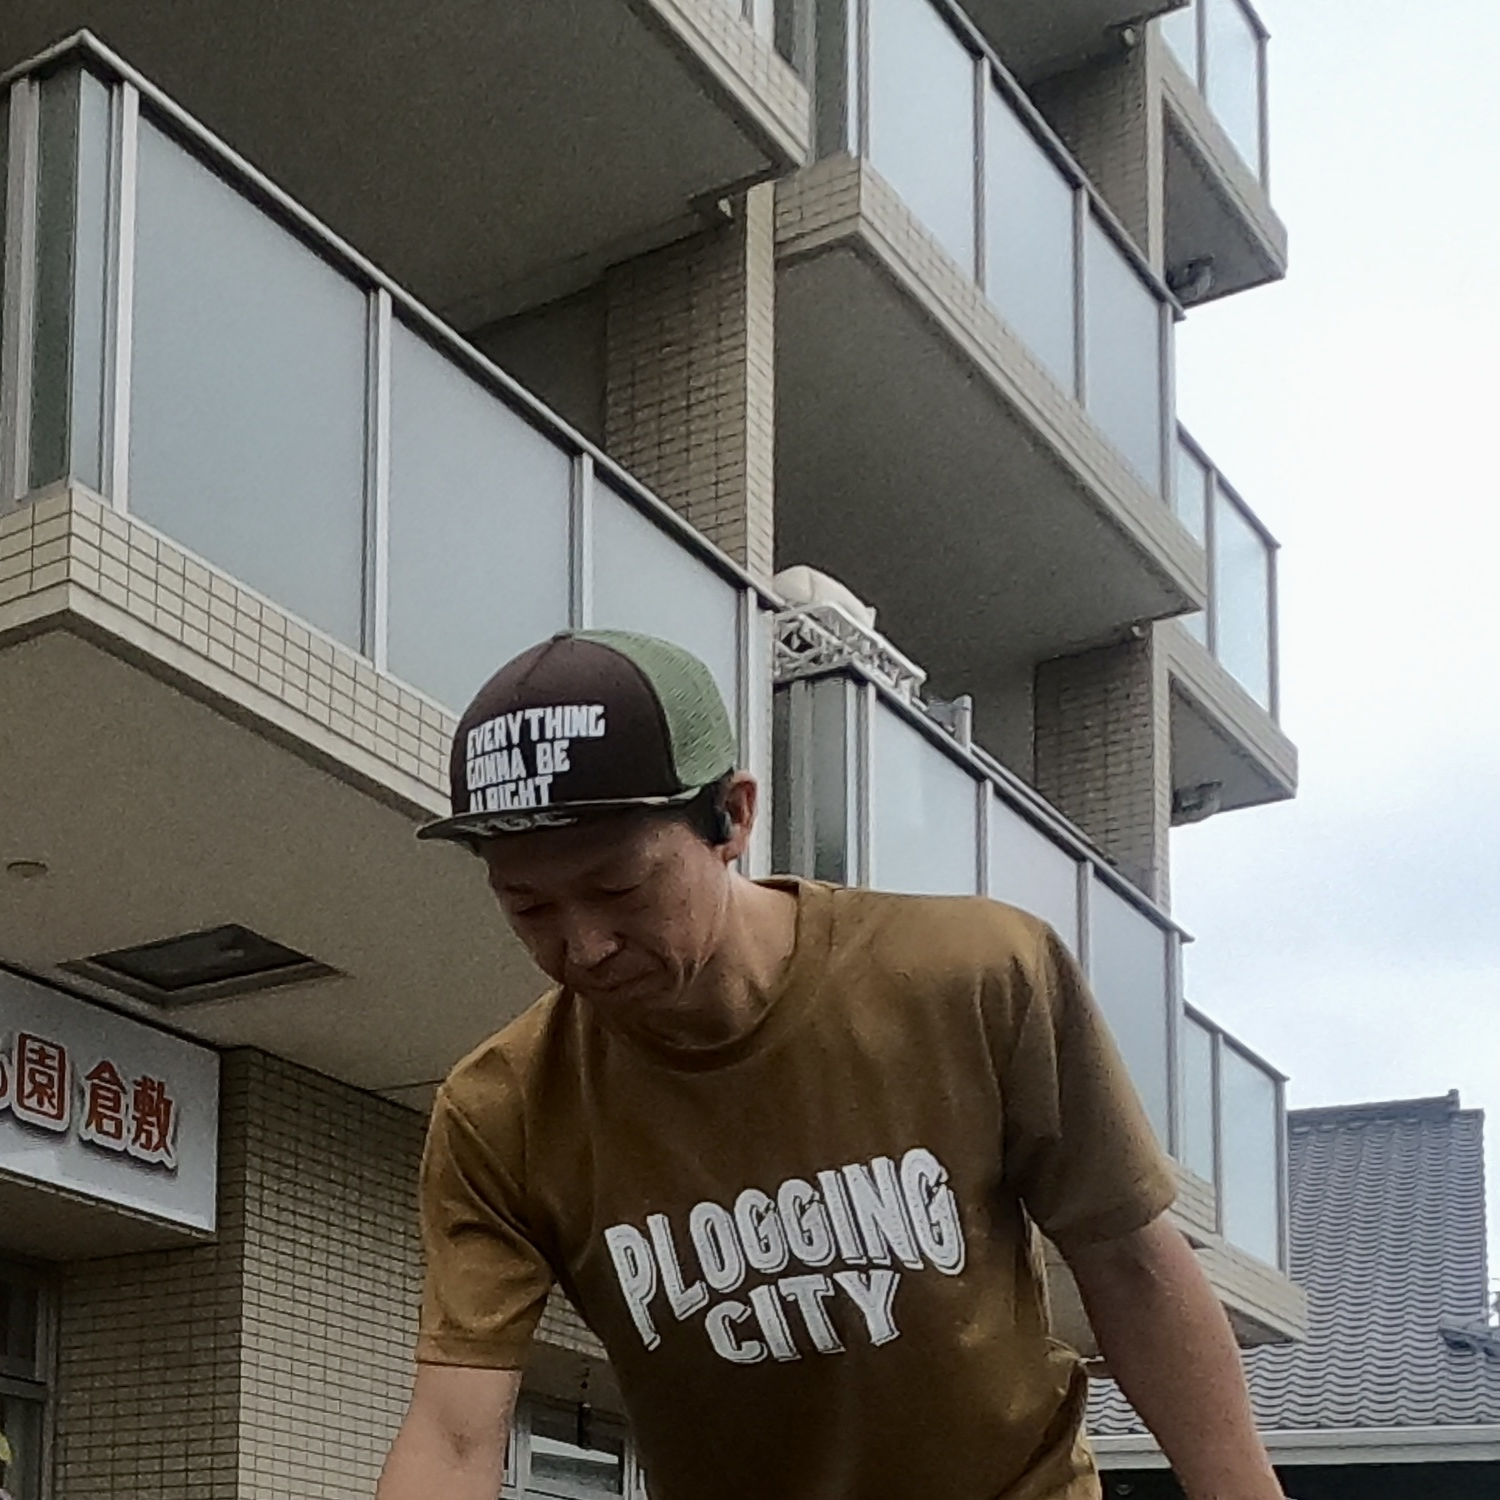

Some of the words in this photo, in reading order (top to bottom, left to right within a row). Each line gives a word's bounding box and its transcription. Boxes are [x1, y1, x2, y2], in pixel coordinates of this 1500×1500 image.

[467, 705, 605, 760] EVERYTHING
[467, 747, 527, 791] GONNA
[536, 739, 570, 775] BE
[82, 1058, 176, 1164] 倉敷
[604, 1147, 965, 1351] PLOGGING
[705, 1269, 901, 1364] CITY
